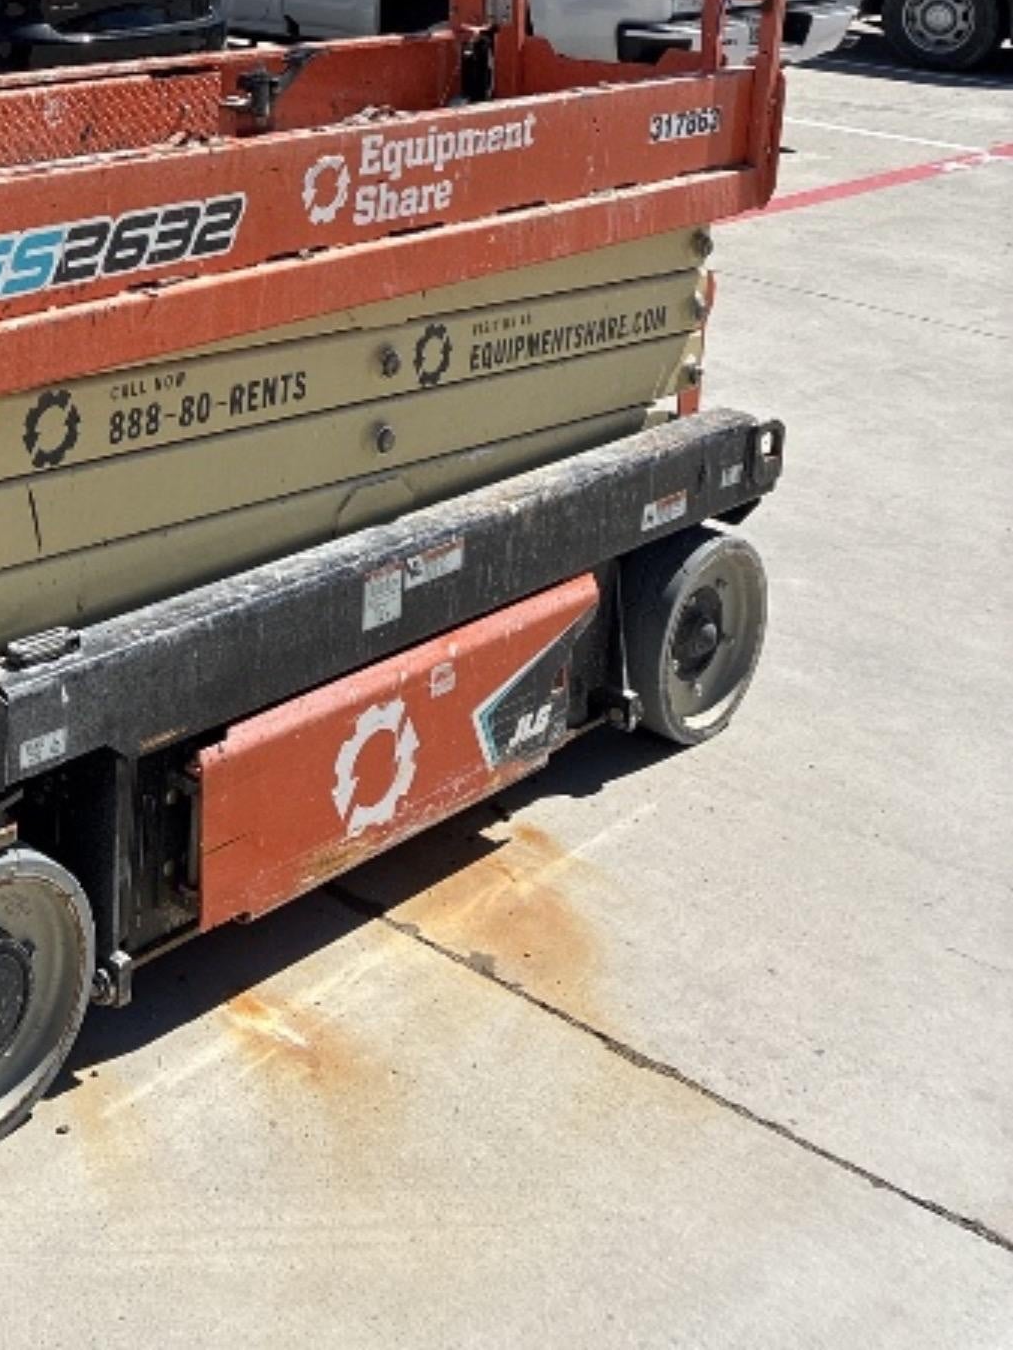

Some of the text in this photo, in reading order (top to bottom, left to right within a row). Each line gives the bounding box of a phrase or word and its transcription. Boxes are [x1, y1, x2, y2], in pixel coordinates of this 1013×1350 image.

[359, 112, 537, 181] Equipment
[353, 179, 453, 226] Share
[109, 371, 307, 444] 888-80-RENTS
[508, 704, 552, 748] JLG
